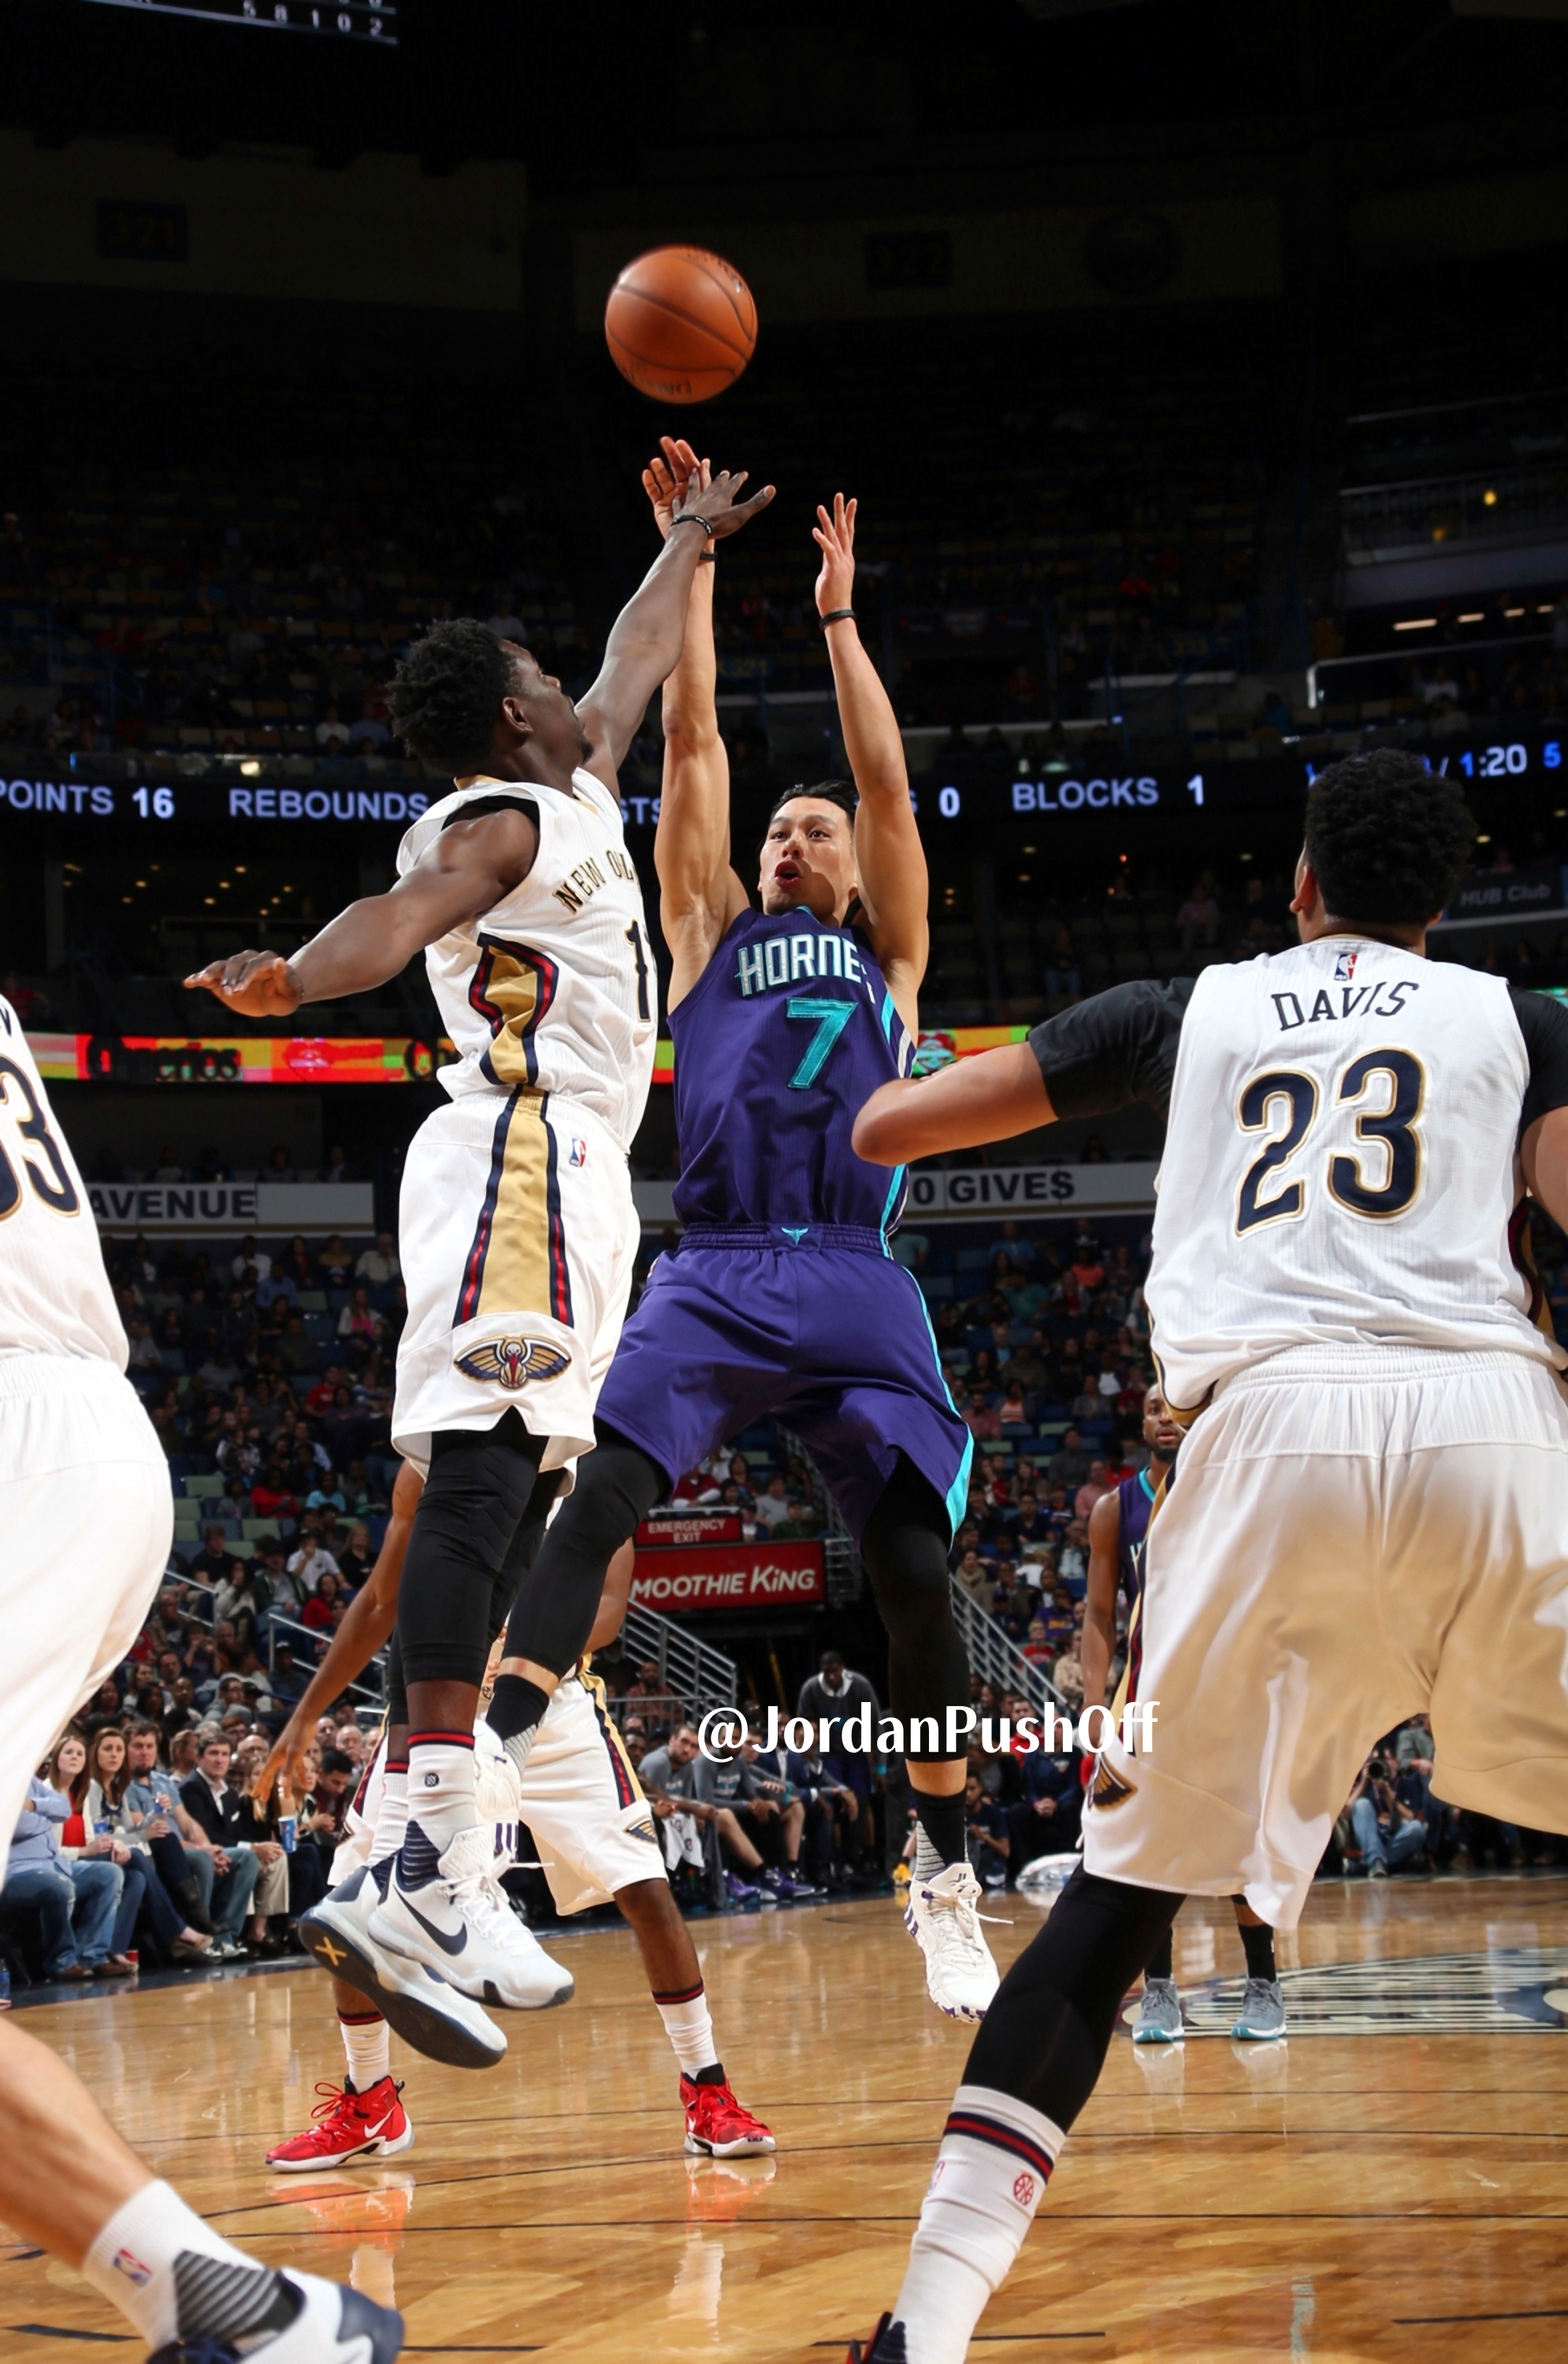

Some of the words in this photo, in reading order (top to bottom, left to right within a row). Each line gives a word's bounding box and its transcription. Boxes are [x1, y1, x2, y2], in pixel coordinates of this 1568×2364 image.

[369, 17, 382, 36] 2
[106, 208, 177, 252] 321
[132, 787, 175, 818] 16
[229, 788, 429, 820] REBOUNDS
[1012, 777, 1159, 811] BLOCKS
[1187, 775, 1204, 806] 1
[552, 857, 606, 915] NEW
[1459, 886, 1503, 906] HUB
[734, 934, 875, 1005] HORNE
[1270, 980, 1420, 1031] DAVIS
[787, 997, 858, 1089] 7
[1234, 1046, 1426, 1234] 23
[90, 1190, 256, 1218] AVENUE
[949, 1171, 1076, 1204] GIVES
[648, 1518, 726, 1534] EMERGENCY
[673, 1532, 701, 1544] EXIT
